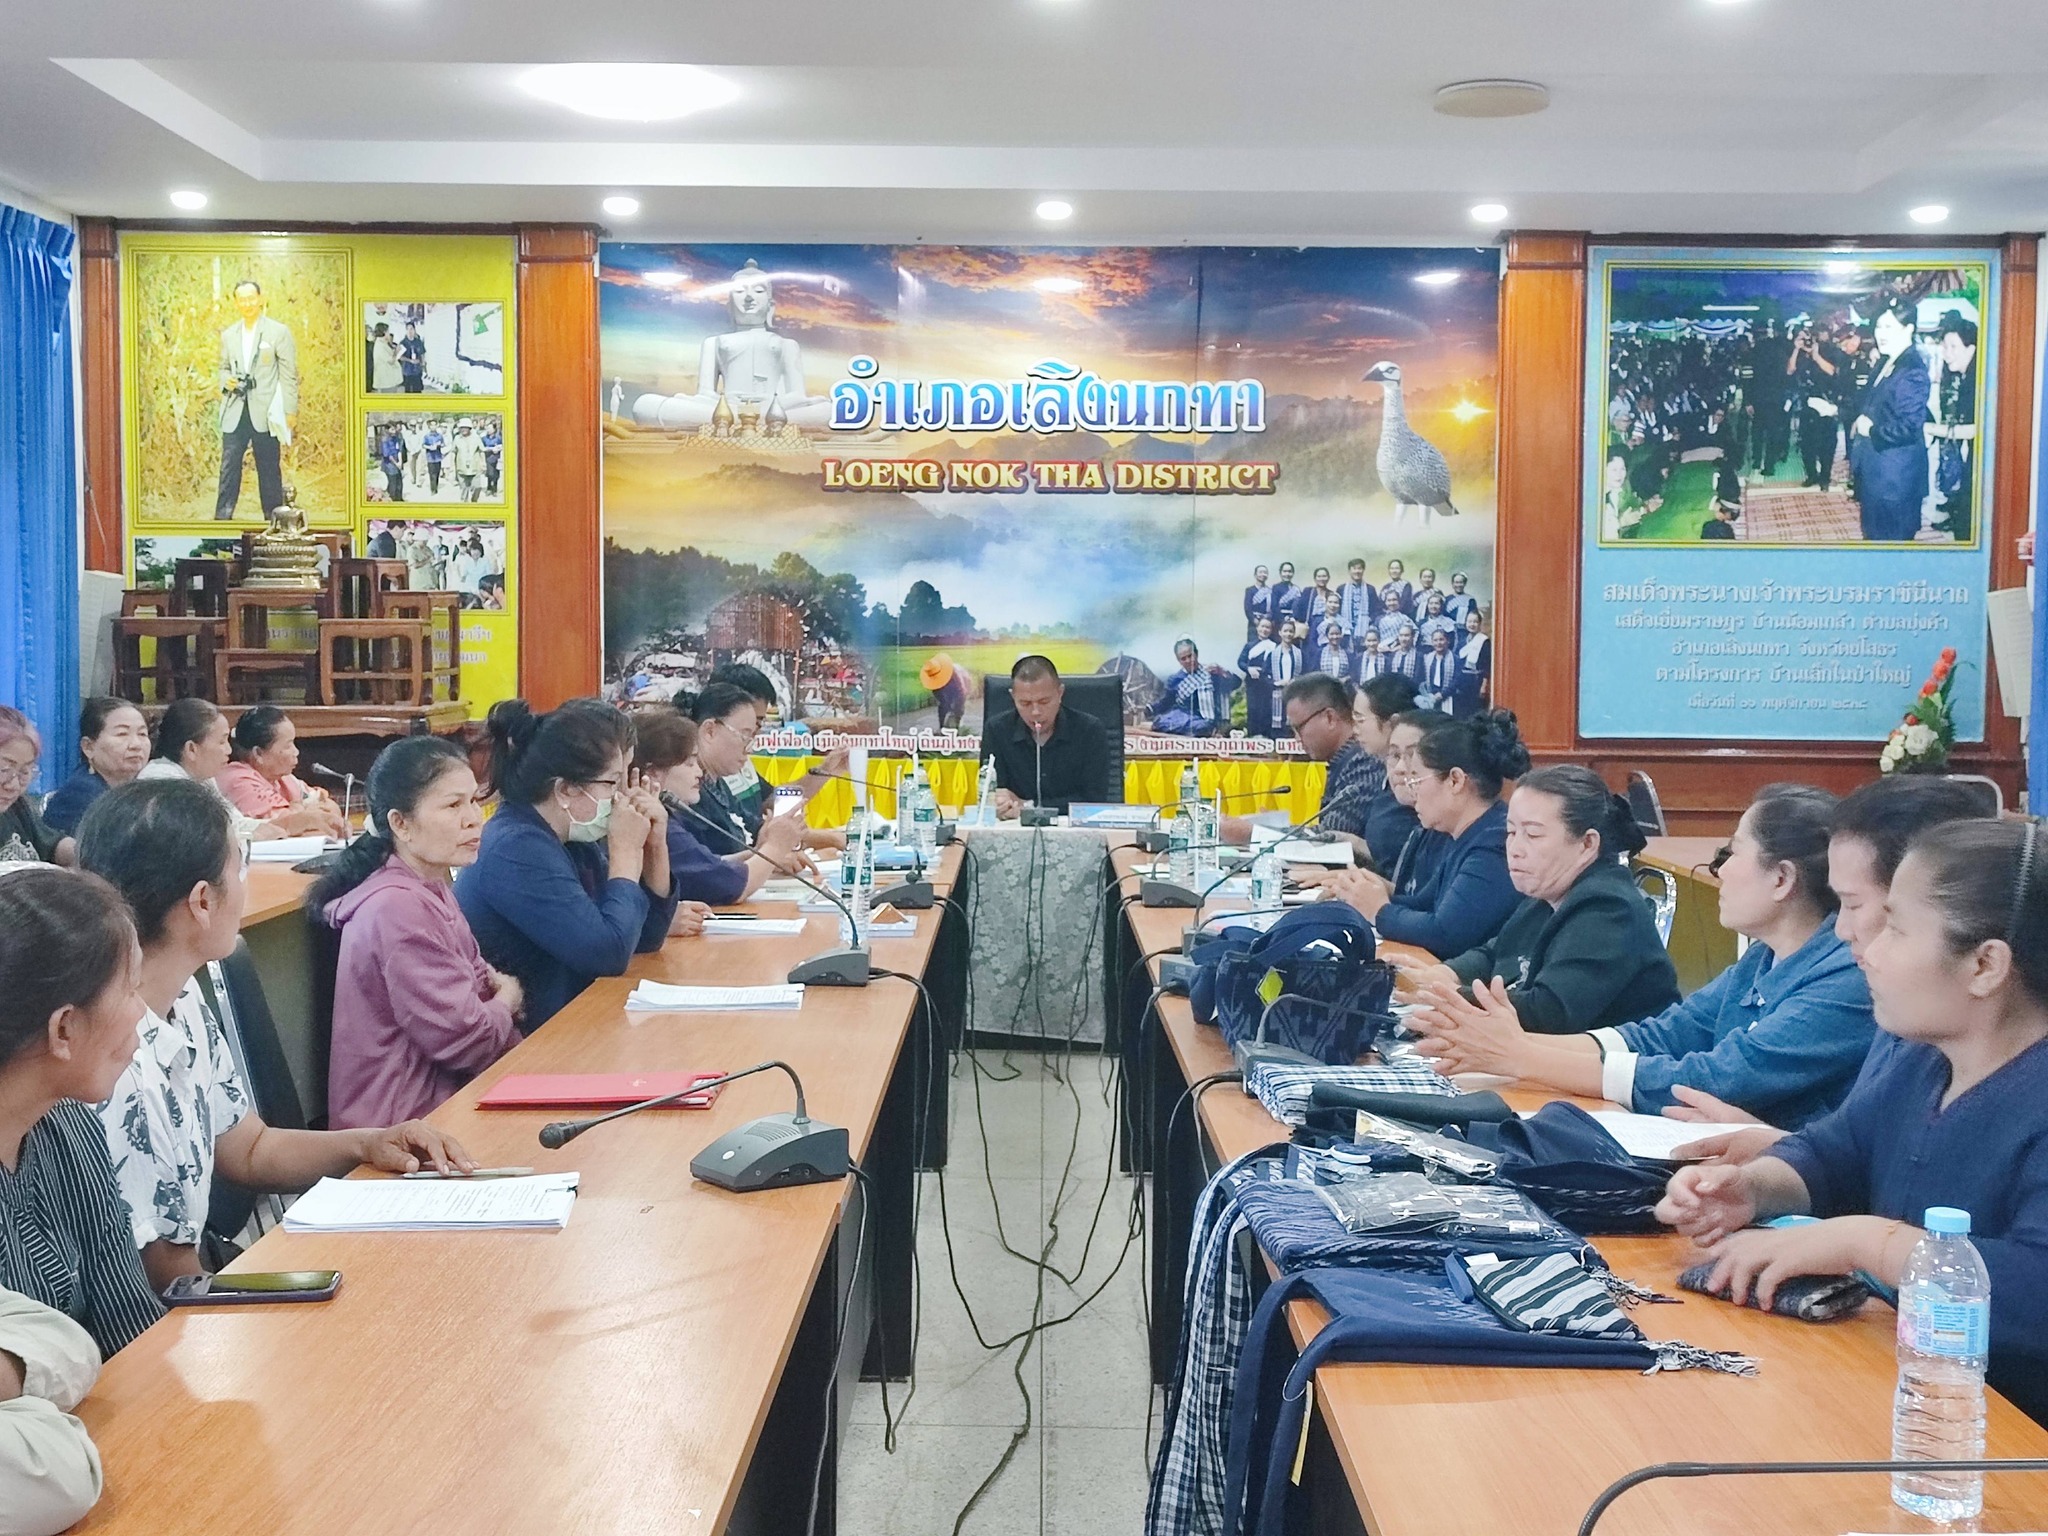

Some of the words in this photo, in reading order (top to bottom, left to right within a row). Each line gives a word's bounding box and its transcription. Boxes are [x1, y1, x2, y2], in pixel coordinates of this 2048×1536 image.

[831, 355, 1265, 431] อำเภอเลิงนกทา
[824, 461, 942, 490] LOENG
[950, 461, 1027, 490] NOK
[1034, 461, 1105, 490] THA
[1115, 461, 1277, 491] DISTRICT
[1602, 576, 1970, 605] สมเด็จพระนางเจ้าพระบรมราชินีนาถ
[1655, 659, 1762, 684] ตามโครงการ
